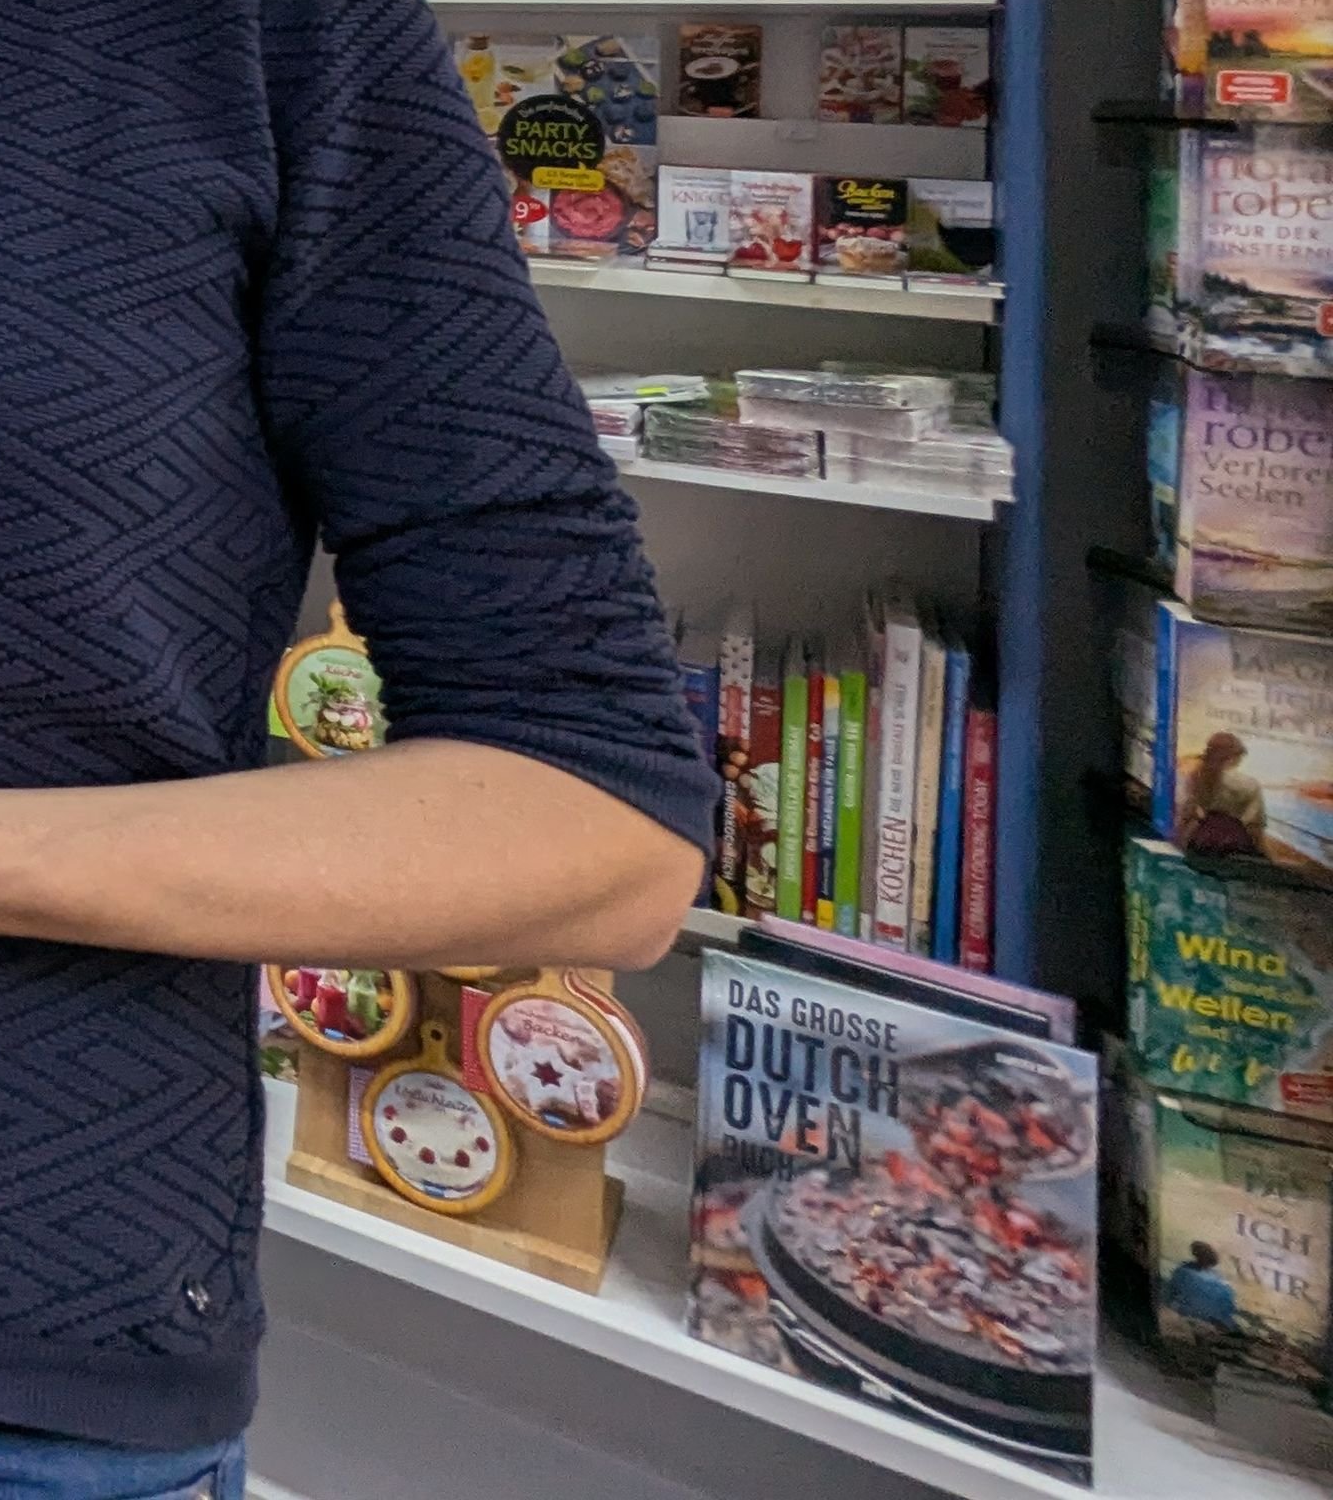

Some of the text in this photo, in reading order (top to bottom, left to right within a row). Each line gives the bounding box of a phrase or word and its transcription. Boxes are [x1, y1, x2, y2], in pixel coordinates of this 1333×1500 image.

[506, 138, 597, 160] SNACKS
[515, 120, 590, 139] PARTY
[877, 814, 908, 906] KOCHEN
[1177, 931, 1287, 978] Wind
[728, 977, 898, 1053] DAS GROSSE
[1156, 978, 1297, 1033] Wellen
[724, 1012, 899, 1119] DUTCH
[723, 1073, 861, 1179] OVEN
